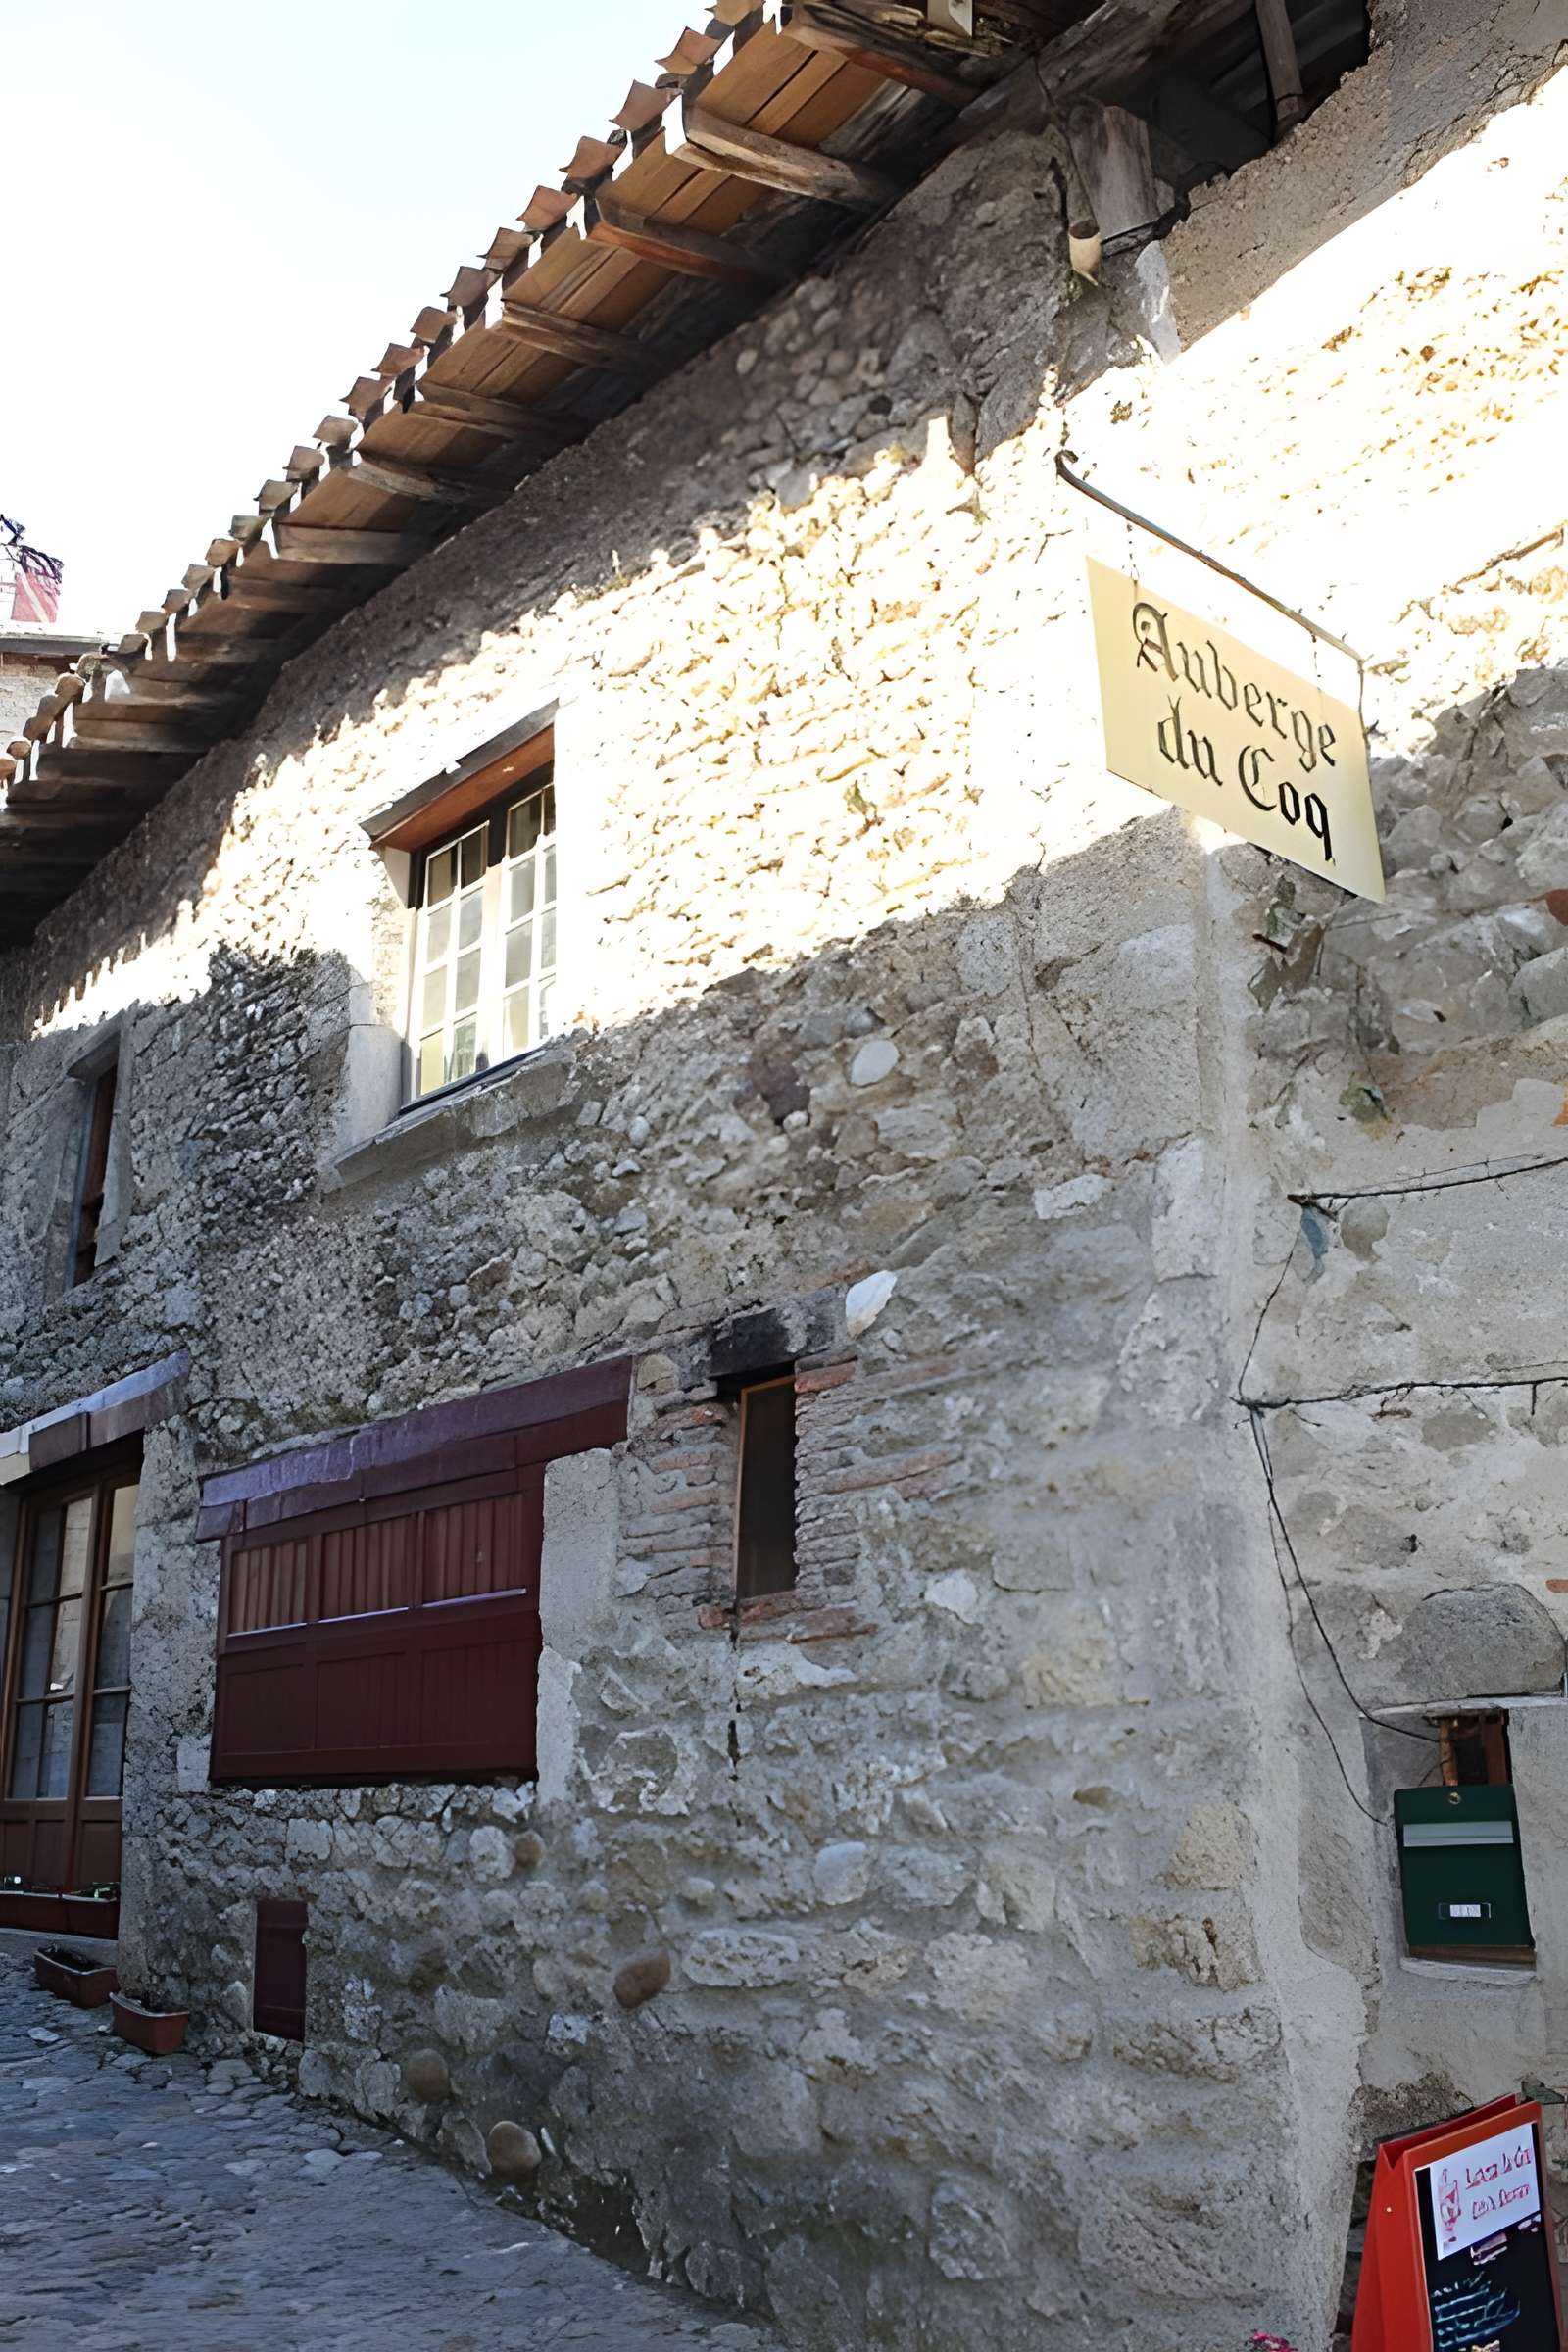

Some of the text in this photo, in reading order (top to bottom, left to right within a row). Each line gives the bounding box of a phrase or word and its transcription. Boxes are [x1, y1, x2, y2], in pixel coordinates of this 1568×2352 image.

[1132, 602, 1336, 772] Auberge
[1157, 695, 1334, 863] du Coq
